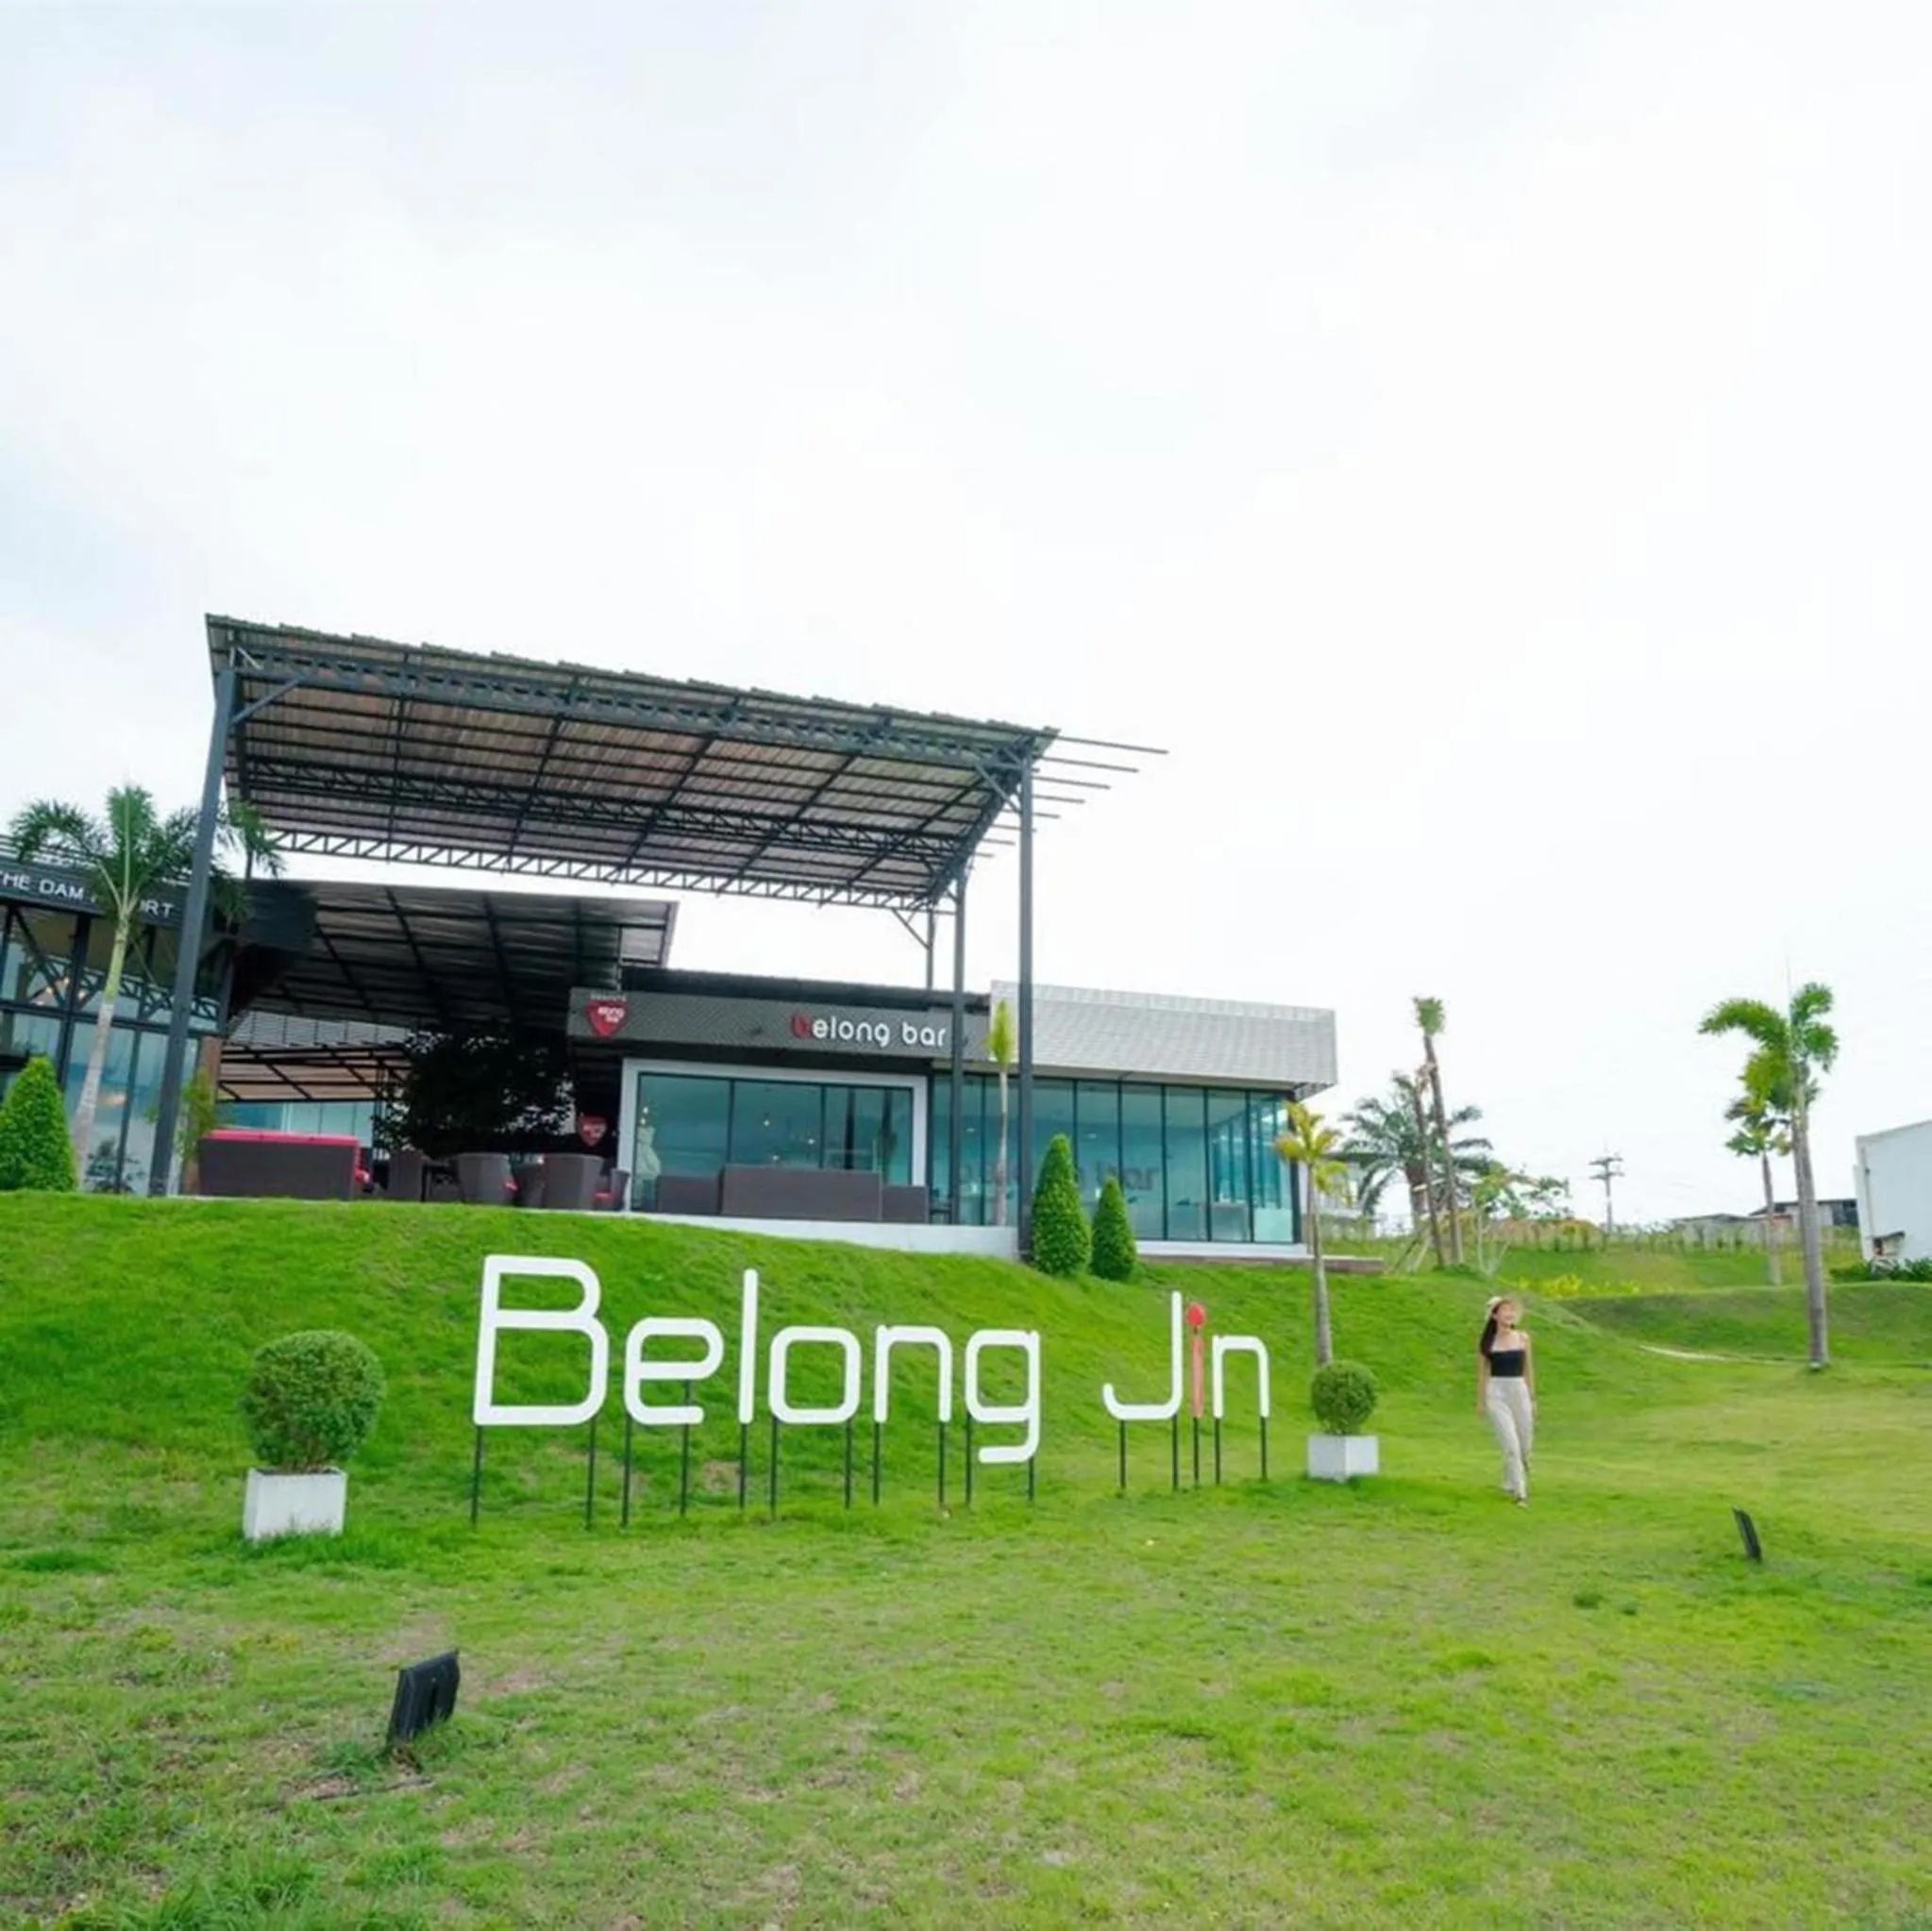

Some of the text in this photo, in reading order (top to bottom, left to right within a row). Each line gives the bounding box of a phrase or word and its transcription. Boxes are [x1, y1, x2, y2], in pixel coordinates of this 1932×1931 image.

[39, 879, 84, 899] DAM
[901, 1021, 947, 1048] bar
[474, 1254, 1270, 1464] Belong Jin
